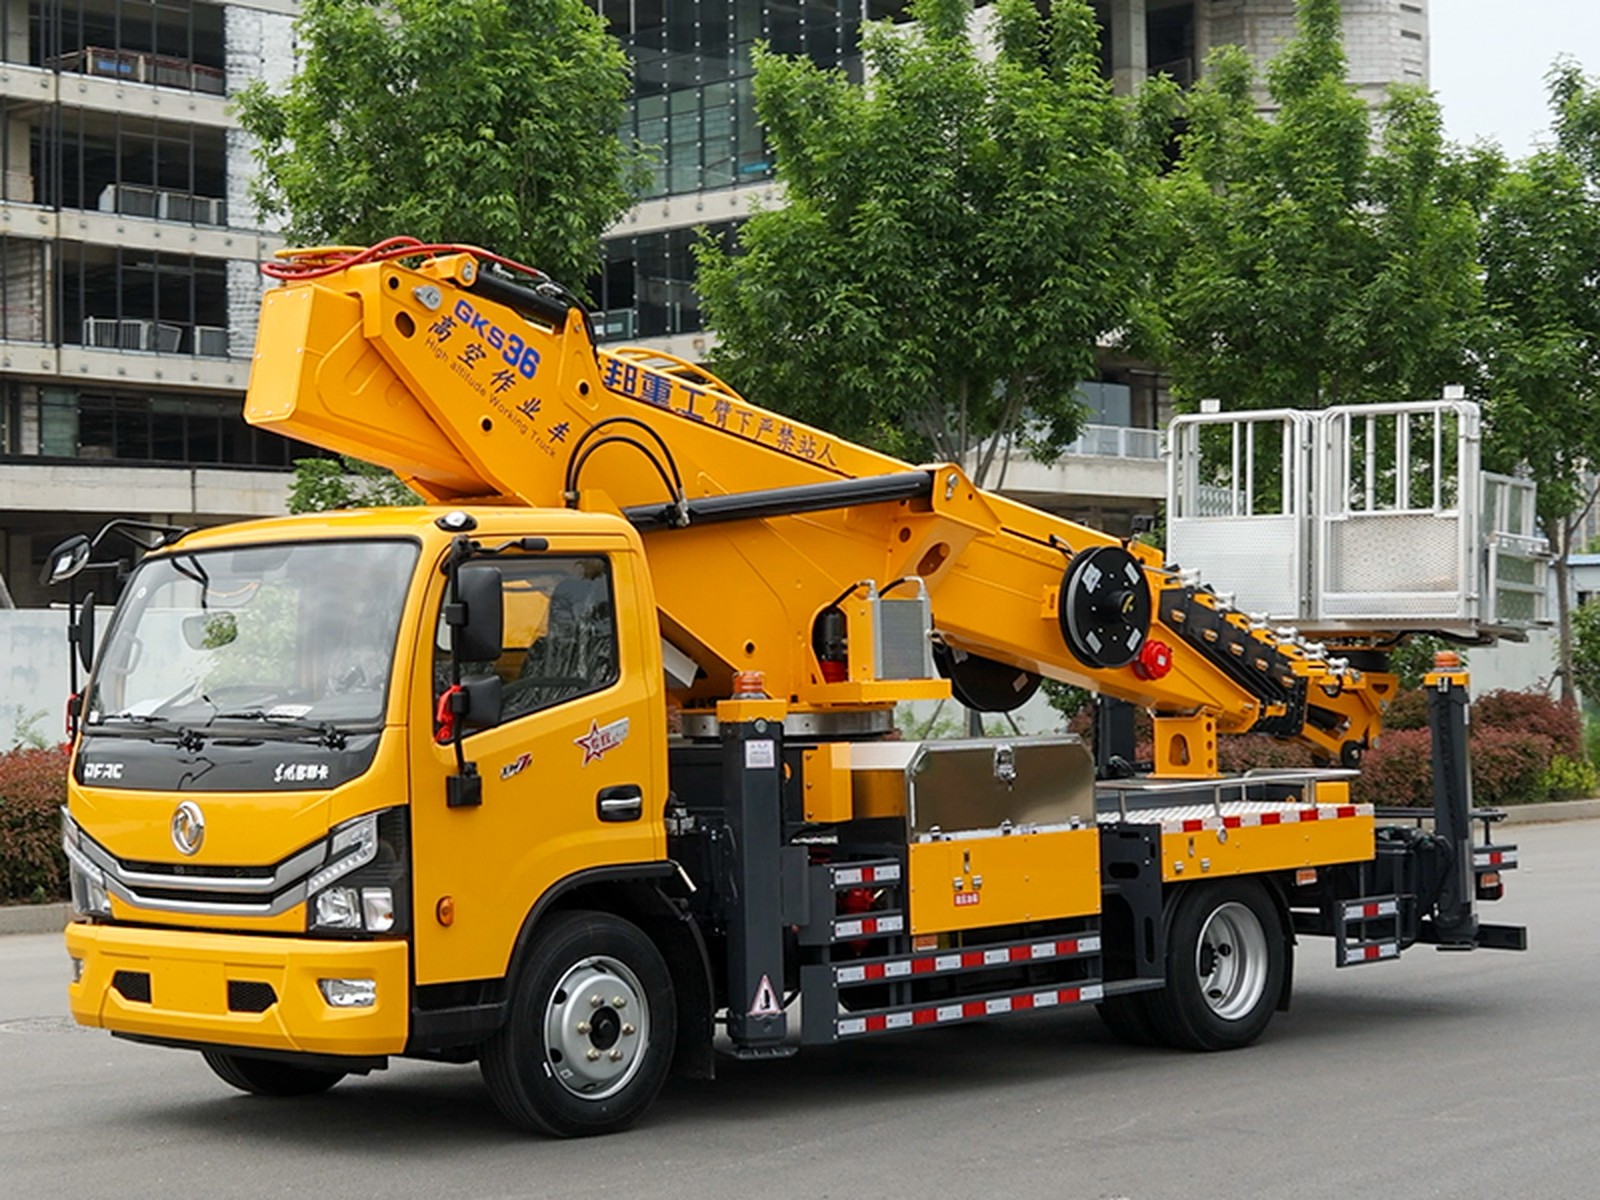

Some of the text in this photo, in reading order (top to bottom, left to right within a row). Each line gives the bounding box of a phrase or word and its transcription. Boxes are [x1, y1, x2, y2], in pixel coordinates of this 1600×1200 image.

[428, 314, 570, 443] 高空作业车
[454, 299, 541, 379] GKS36
[425, 337, 449, 362] High
[490, 396, 528, 434] Working
[530, 430, 555, 457] Truck
[711, 399, 837, 466] 臂下严禁站人
